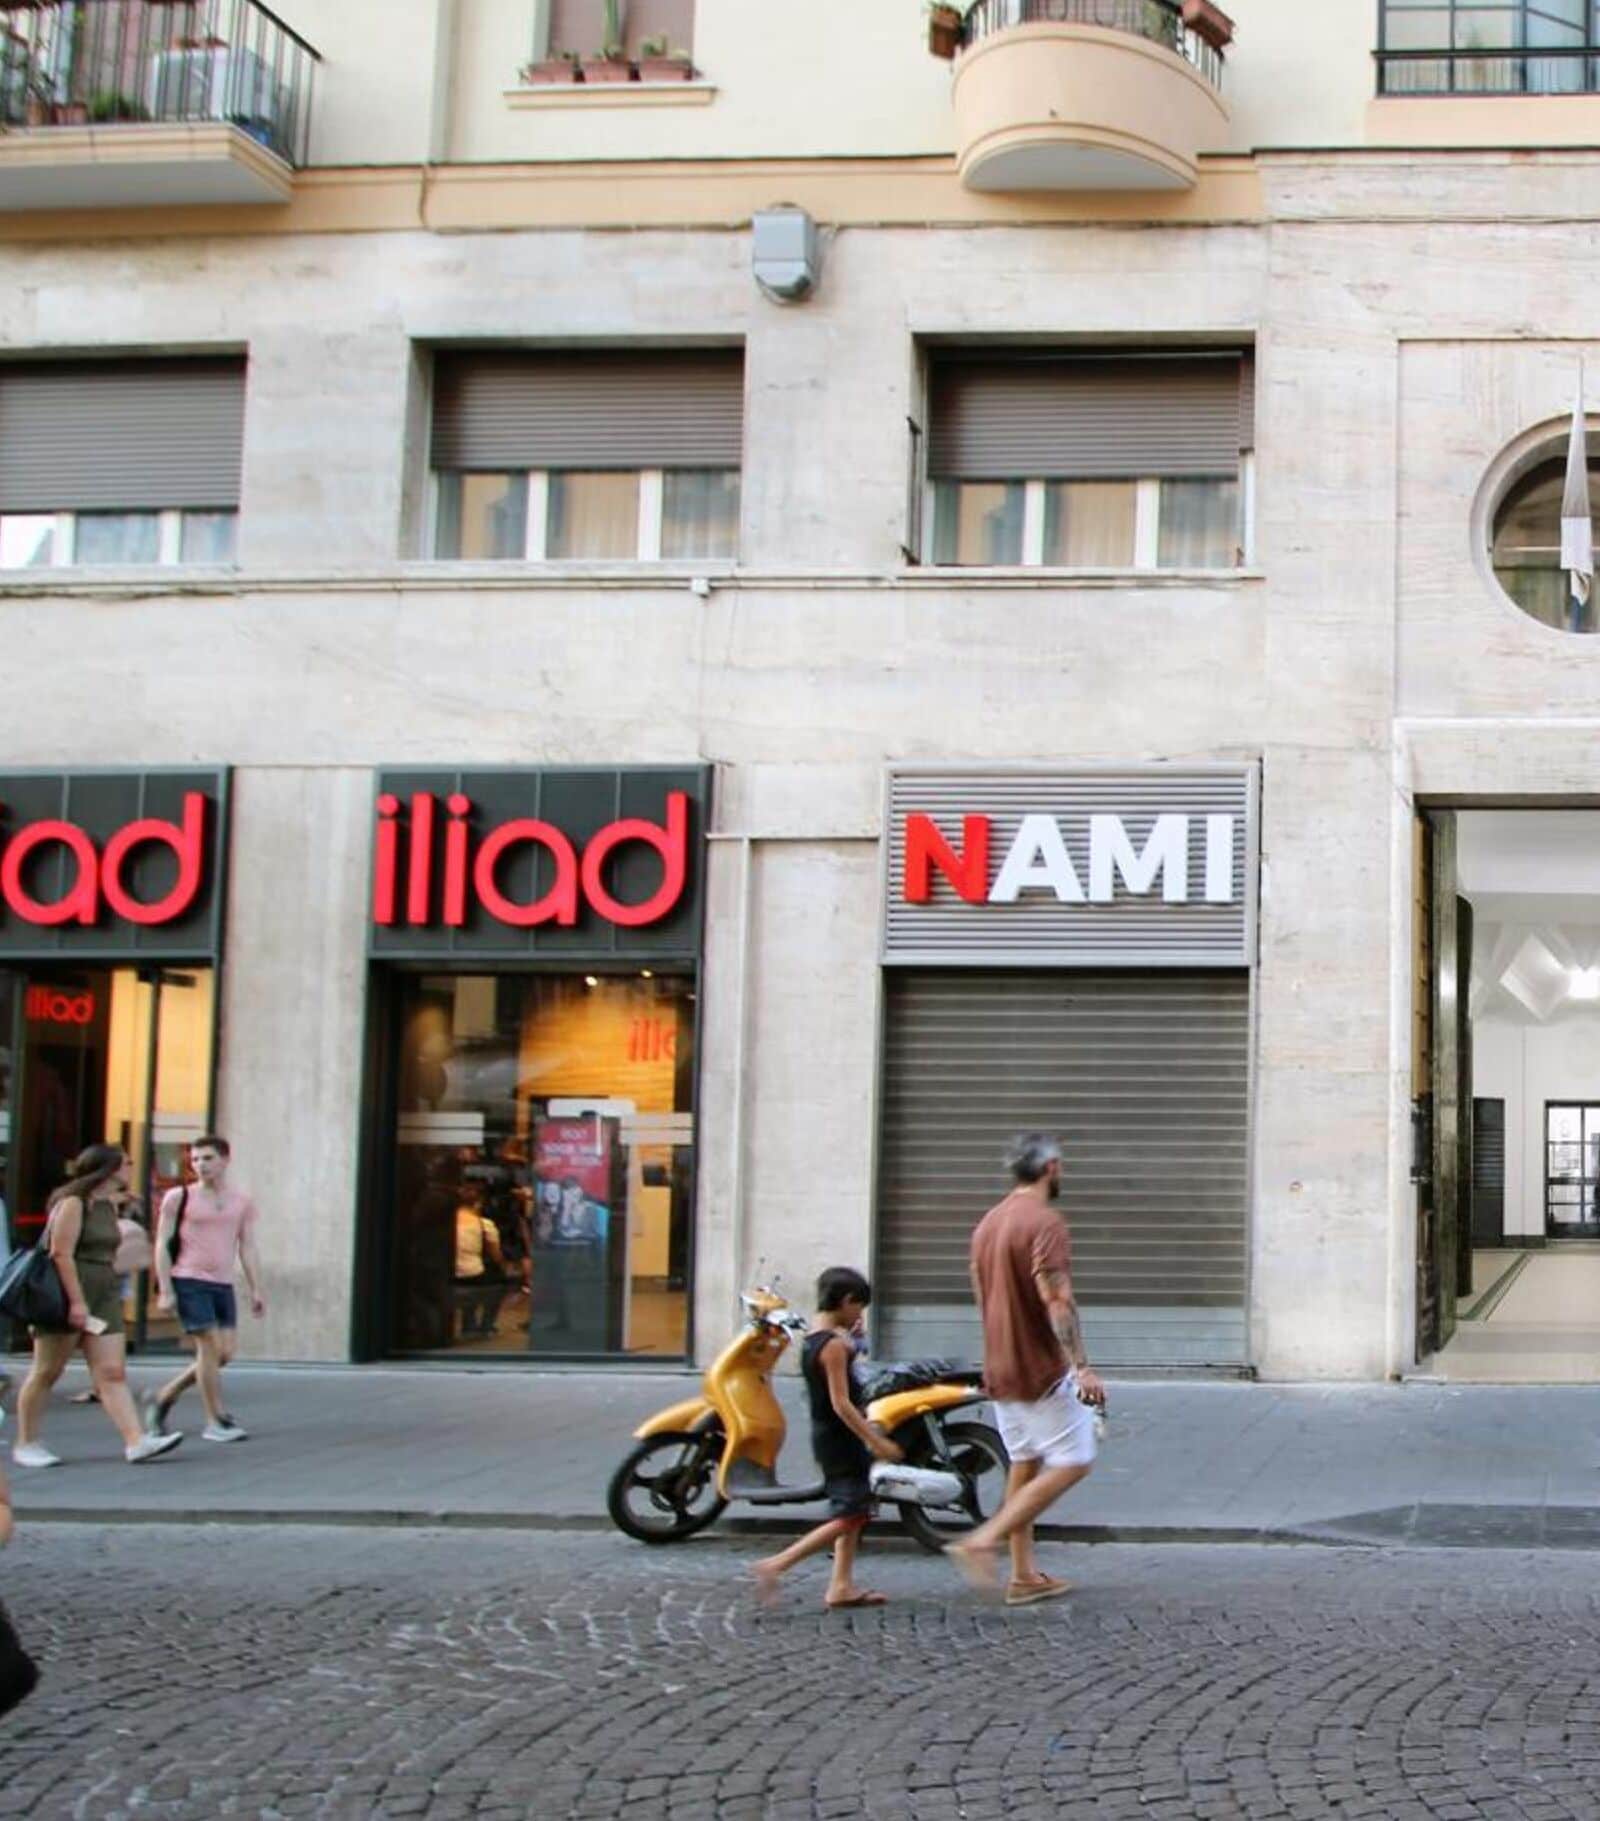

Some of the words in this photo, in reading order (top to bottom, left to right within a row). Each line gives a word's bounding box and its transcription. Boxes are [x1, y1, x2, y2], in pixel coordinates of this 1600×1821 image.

[0, 791, 205, 926] ad
[373, 791, 688, 926] iliad
[902, 811, 1234, 904] NAMI
